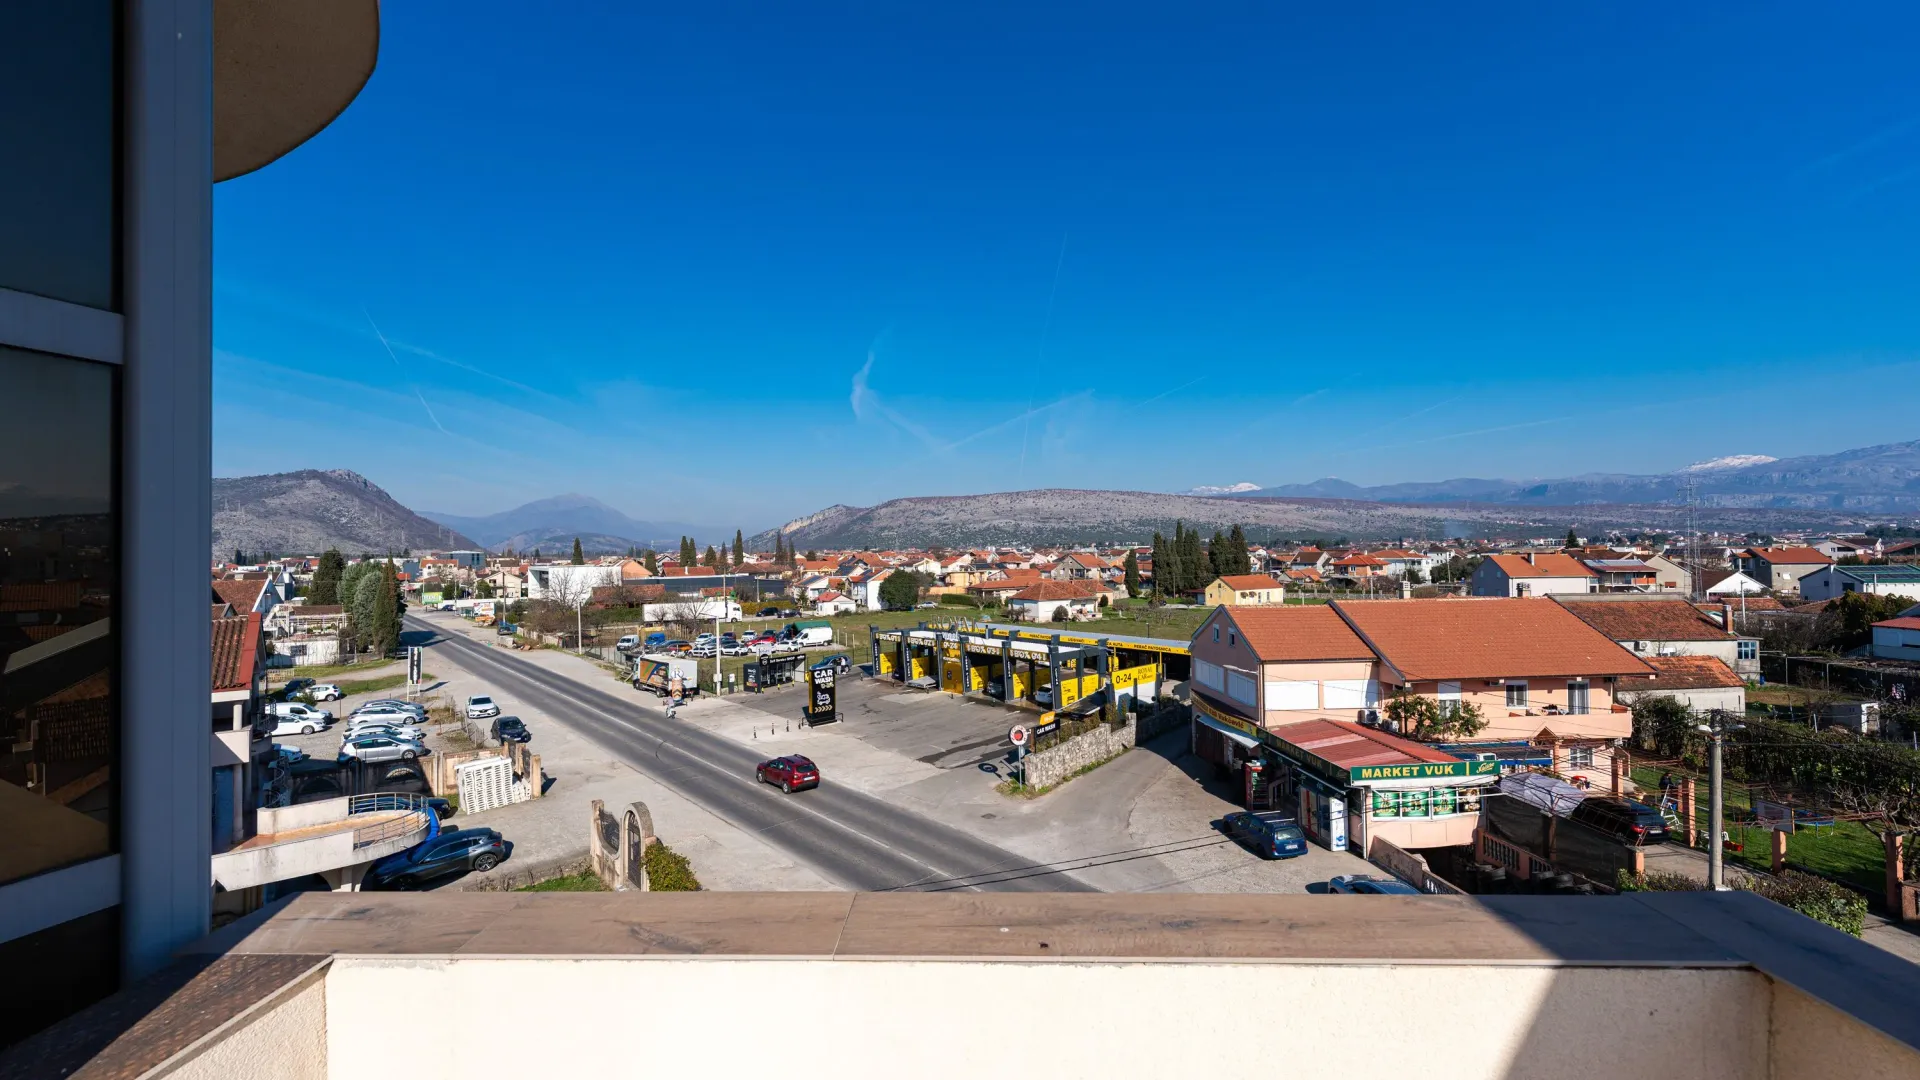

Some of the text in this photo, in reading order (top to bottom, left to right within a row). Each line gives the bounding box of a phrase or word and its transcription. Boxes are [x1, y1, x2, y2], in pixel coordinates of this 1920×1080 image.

[971, 645, 986, 654] BOX
[1014, 650, 1031, 659] BOX
[814, 669, 833, 678] CAR
[815, 676, 834, 685] WASH
[1115, 673, 1132, 684] 0-24
[1362, 765, 1454, 778] MARKET VUK
